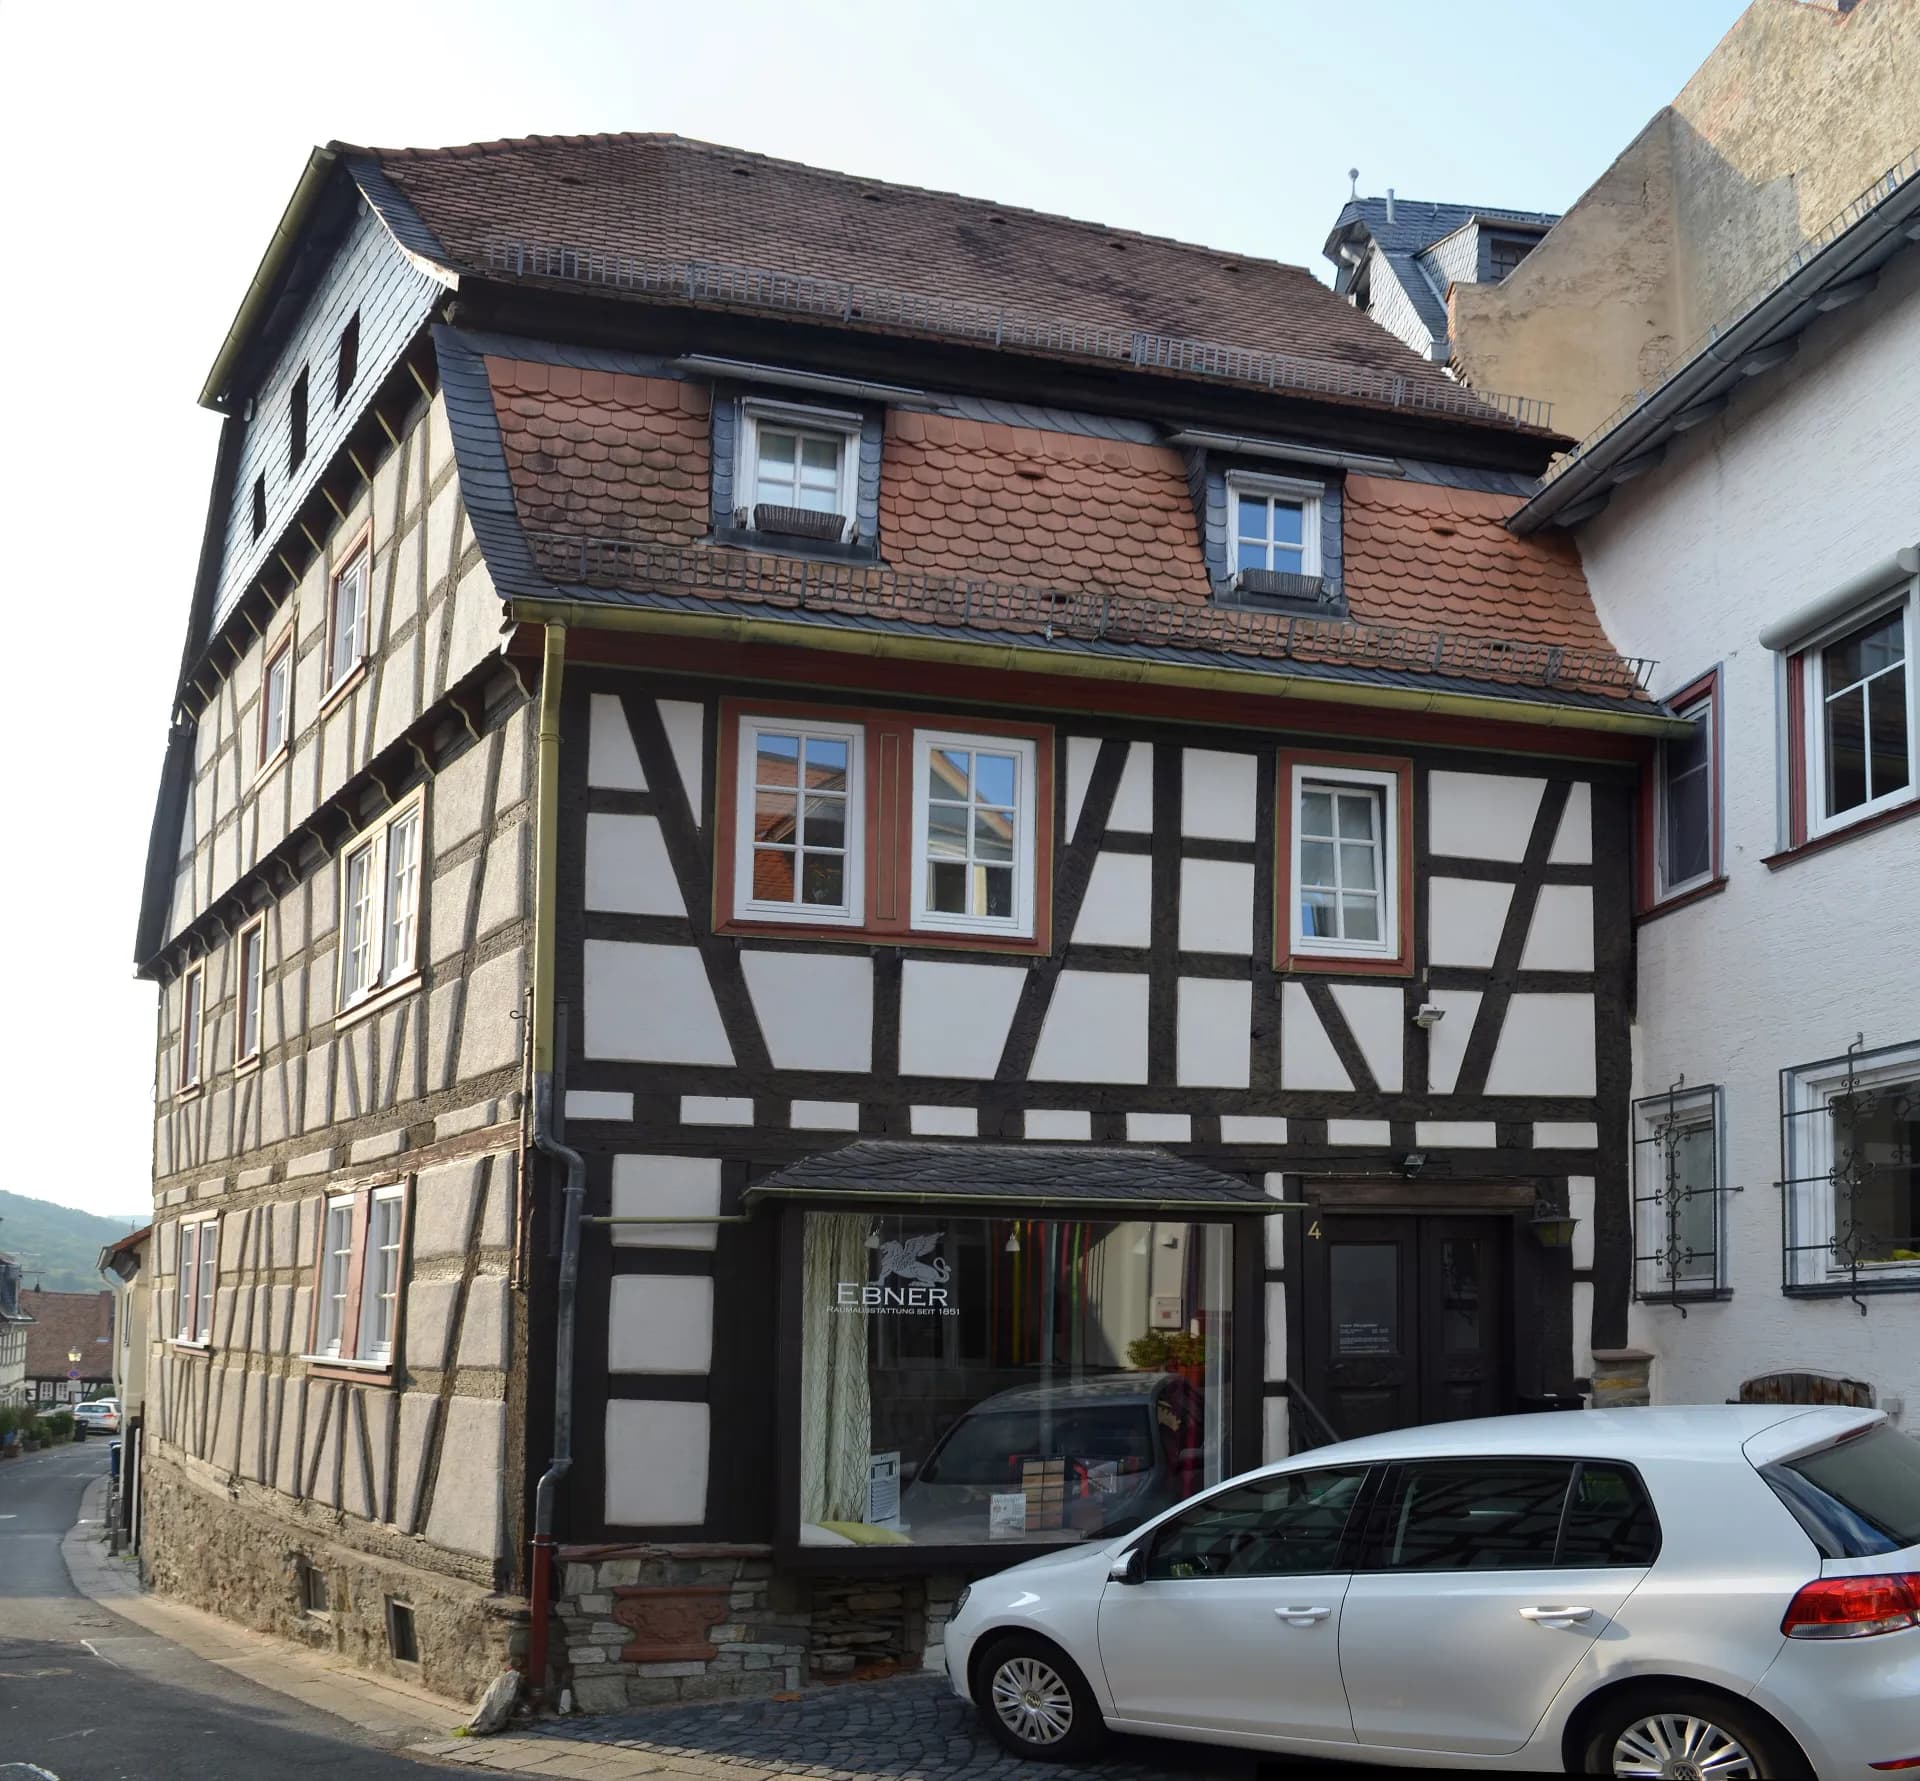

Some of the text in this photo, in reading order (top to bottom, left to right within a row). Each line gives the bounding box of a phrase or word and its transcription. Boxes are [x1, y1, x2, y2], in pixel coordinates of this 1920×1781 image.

[1307, 1221, 1322, 1240] 4
[837, 1282, 948, 1307] EBNER
[917, 1307, 935, 1316] SEIT
[939, 1307, 960, 1316] 1851
